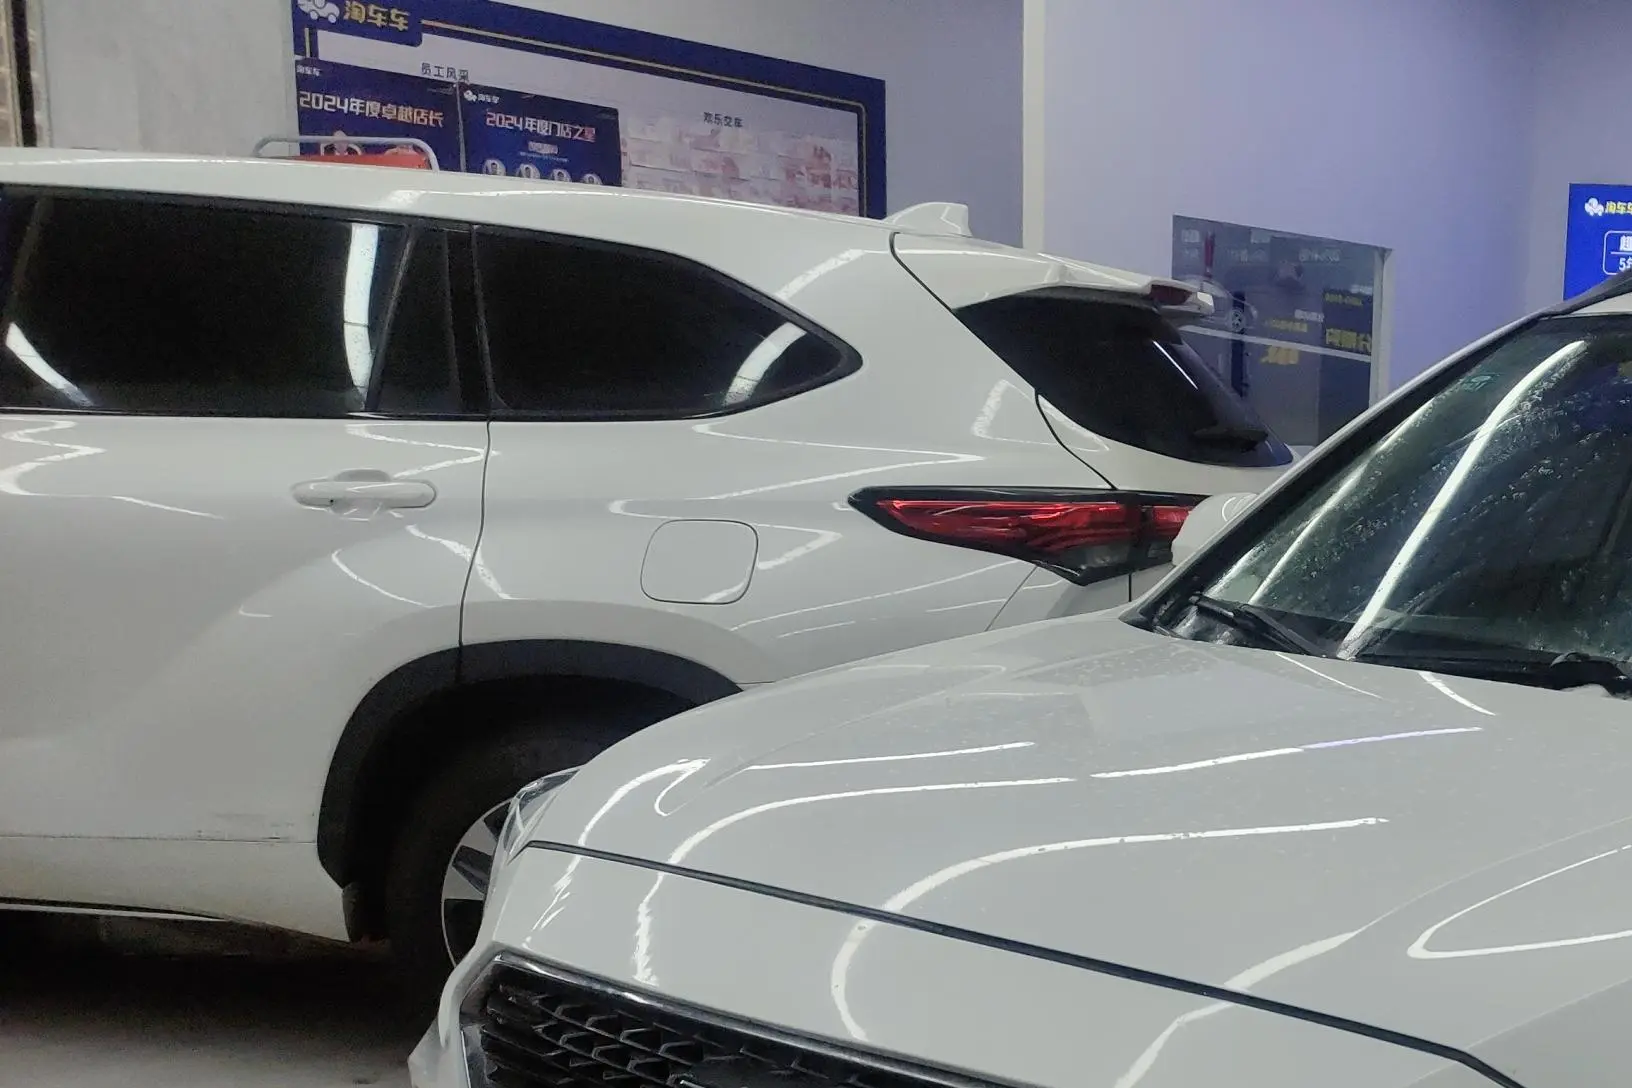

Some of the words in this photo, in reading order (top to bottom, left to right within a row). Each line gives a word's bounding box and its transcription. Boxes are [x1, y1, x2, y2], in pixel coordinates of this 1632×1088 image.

[343, 0, 411, 32] 淘车车
[421, 62, 470, 82] 员工风采
[299, 90, 445, 128] 2024年度卓越店长
[703, 111, 744, 128] 欢乐交车
[485, 111, 597, 143] 2024年度门店之星
